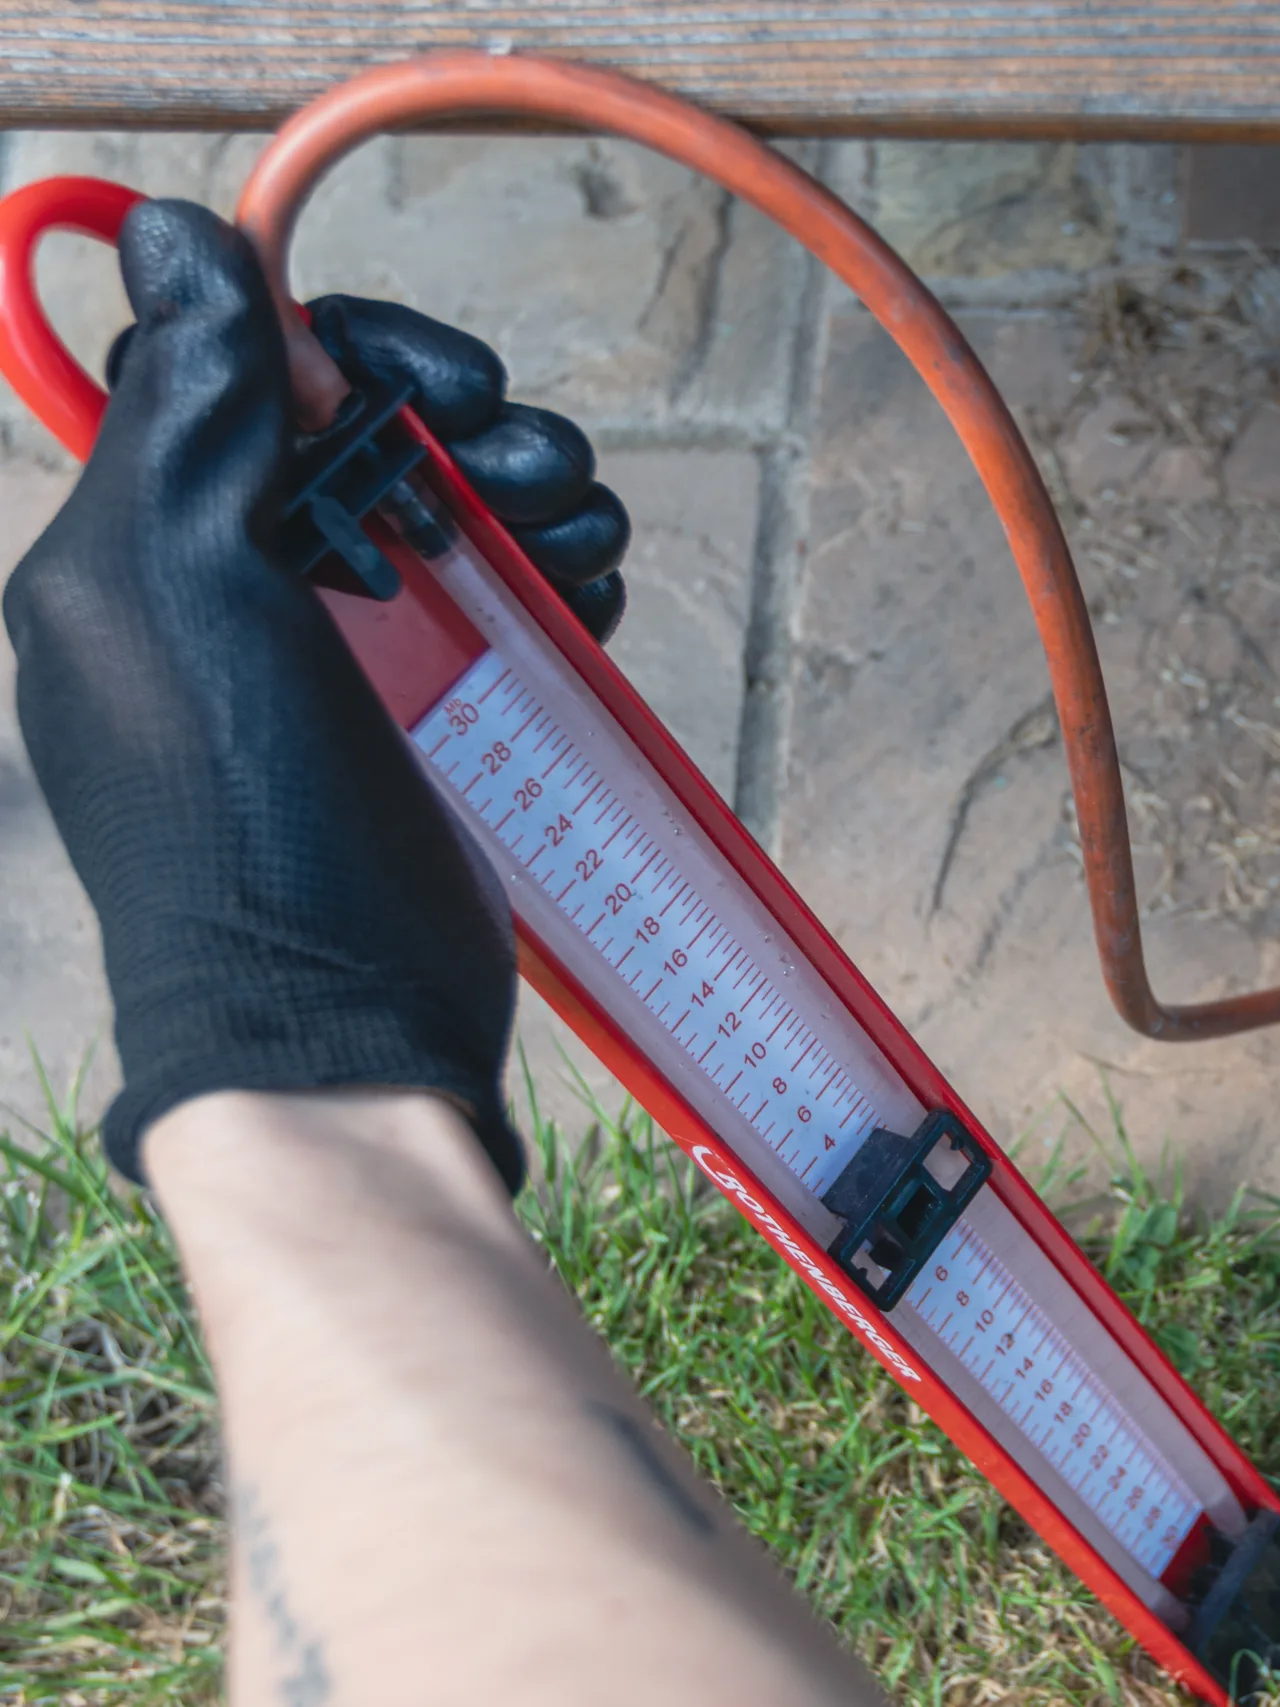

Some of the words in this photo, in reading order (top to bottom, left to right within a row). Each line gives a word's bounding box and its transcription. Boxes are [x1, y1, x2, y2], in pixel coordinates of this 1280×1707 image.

[449, 703, 479, 736] 30
[481, 741, 512, 775] 28
[513, 777, 544, 812] 26
[544, 812, 574, 847] 24
[575, 848, 604, 882] 22
[605, 882, 634, 916] 20
[635, 916, 661, 945] 18
[664, 948, 689, 977] 16
[691, 981, 716, 1008] 14
[718, 1011, 743, 1039] 12
[744, 1042, 767, 1069] 10
[772, 1076, 789, 1096] 8
[796, 1105, 812, 1125] 6
[823, 1134, 837, 1152] 4
[692, 1145, 922, 1382] ROTHENBERGER
[935, 1265, 949, 1282] 6
[956, 1290, 970, 1307] 8
[975, 1309, 995, 1333] 10
[995, 1332, 1015, 1356] 12
[1015, 1356, 1034, 1380] 14
[1034, 1378, 1053, 1402] 16
[1053, 1401, 1073, 1424] 18
